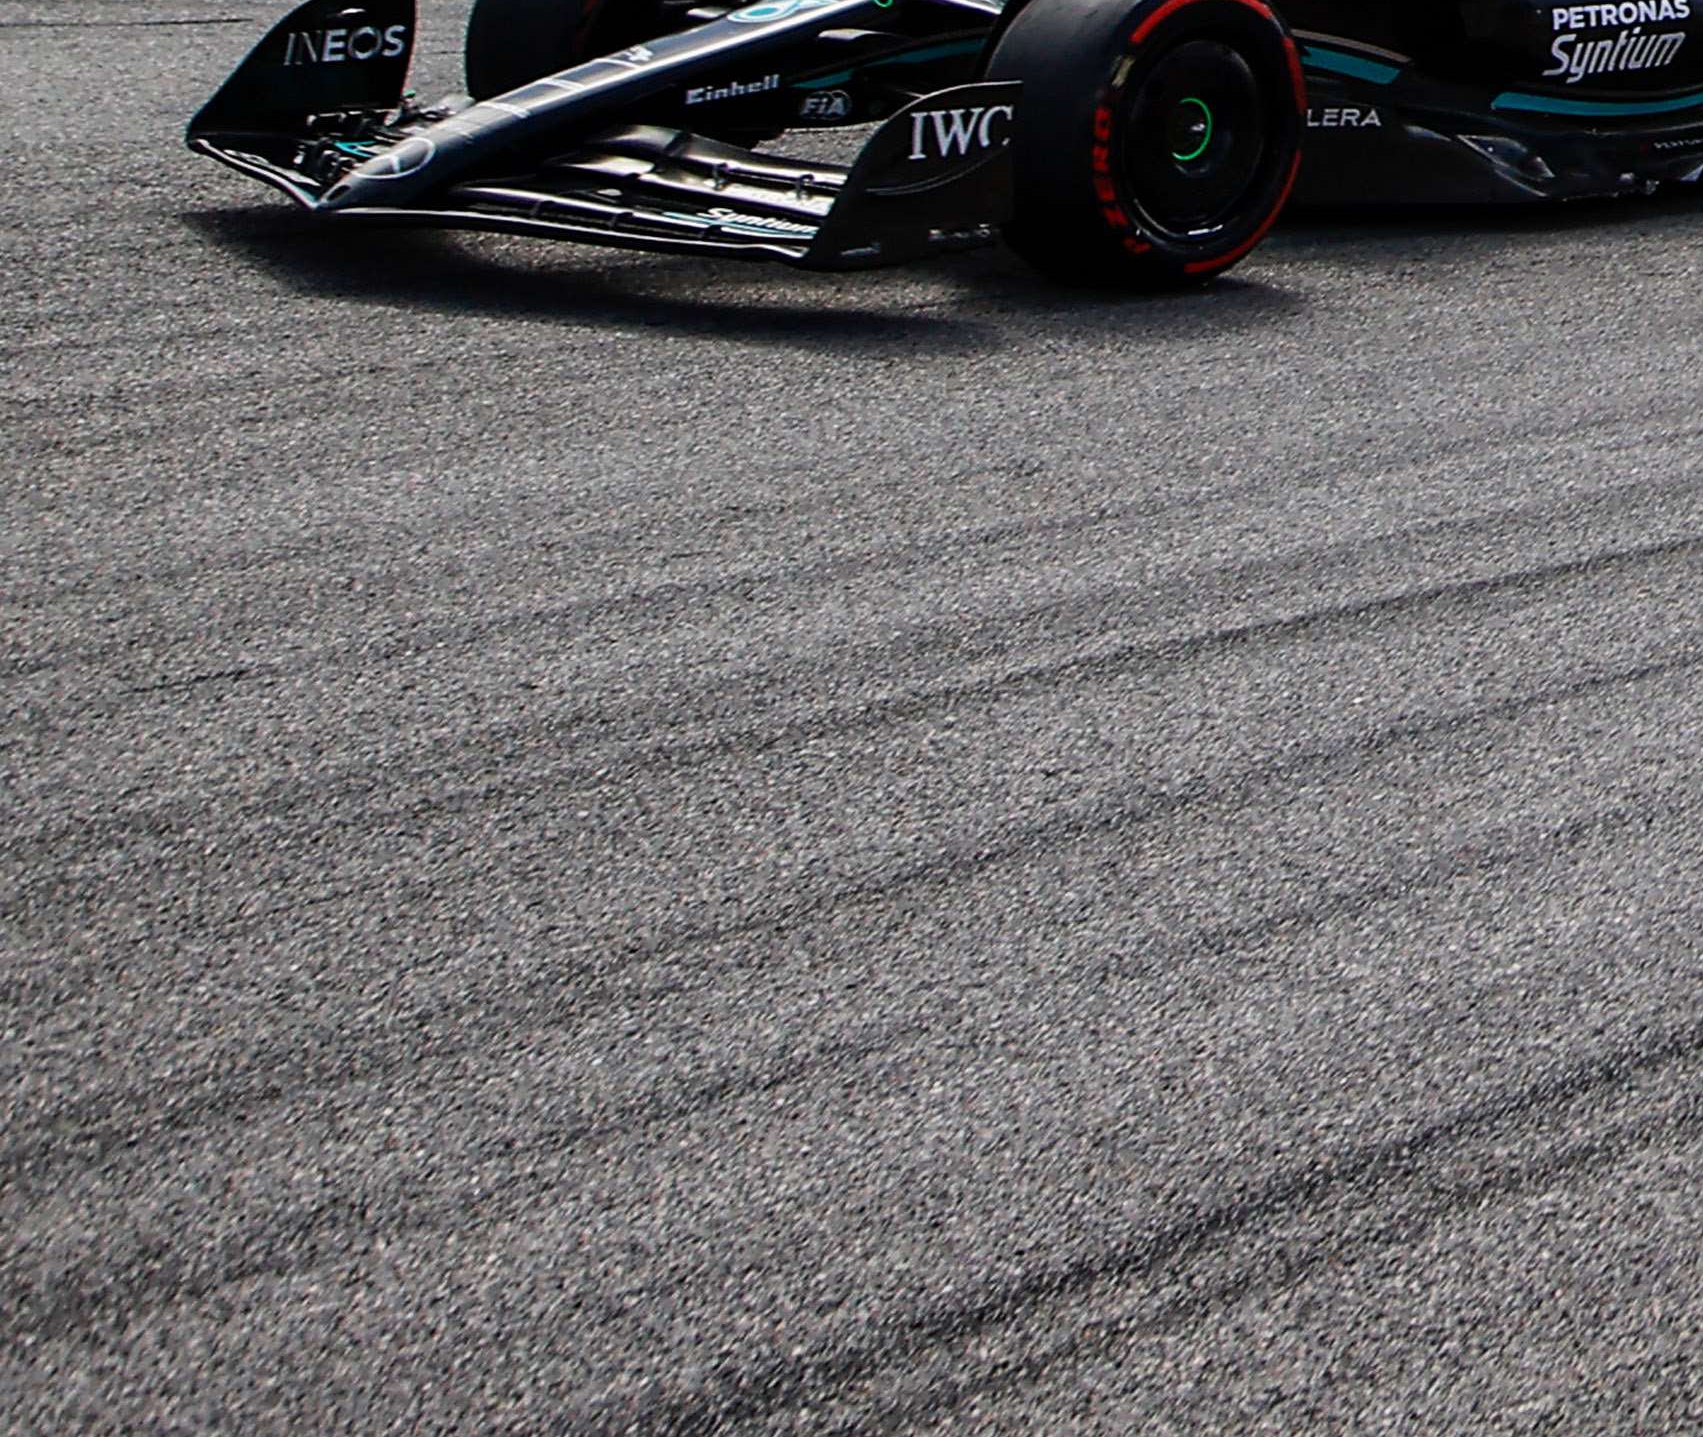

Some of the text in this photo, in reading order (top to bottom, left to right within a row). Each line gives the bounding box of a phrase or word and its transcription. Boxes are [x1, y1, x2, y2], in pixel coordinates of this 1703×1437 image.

[284, 25, 406, 66] INEOS
[1542, 29, 1687, 84] Syntium
[685, 73, 780, 105] Einhell
[908, 105, 1014, 161] IWC
[1306, 108, 1382, 128] LERA
